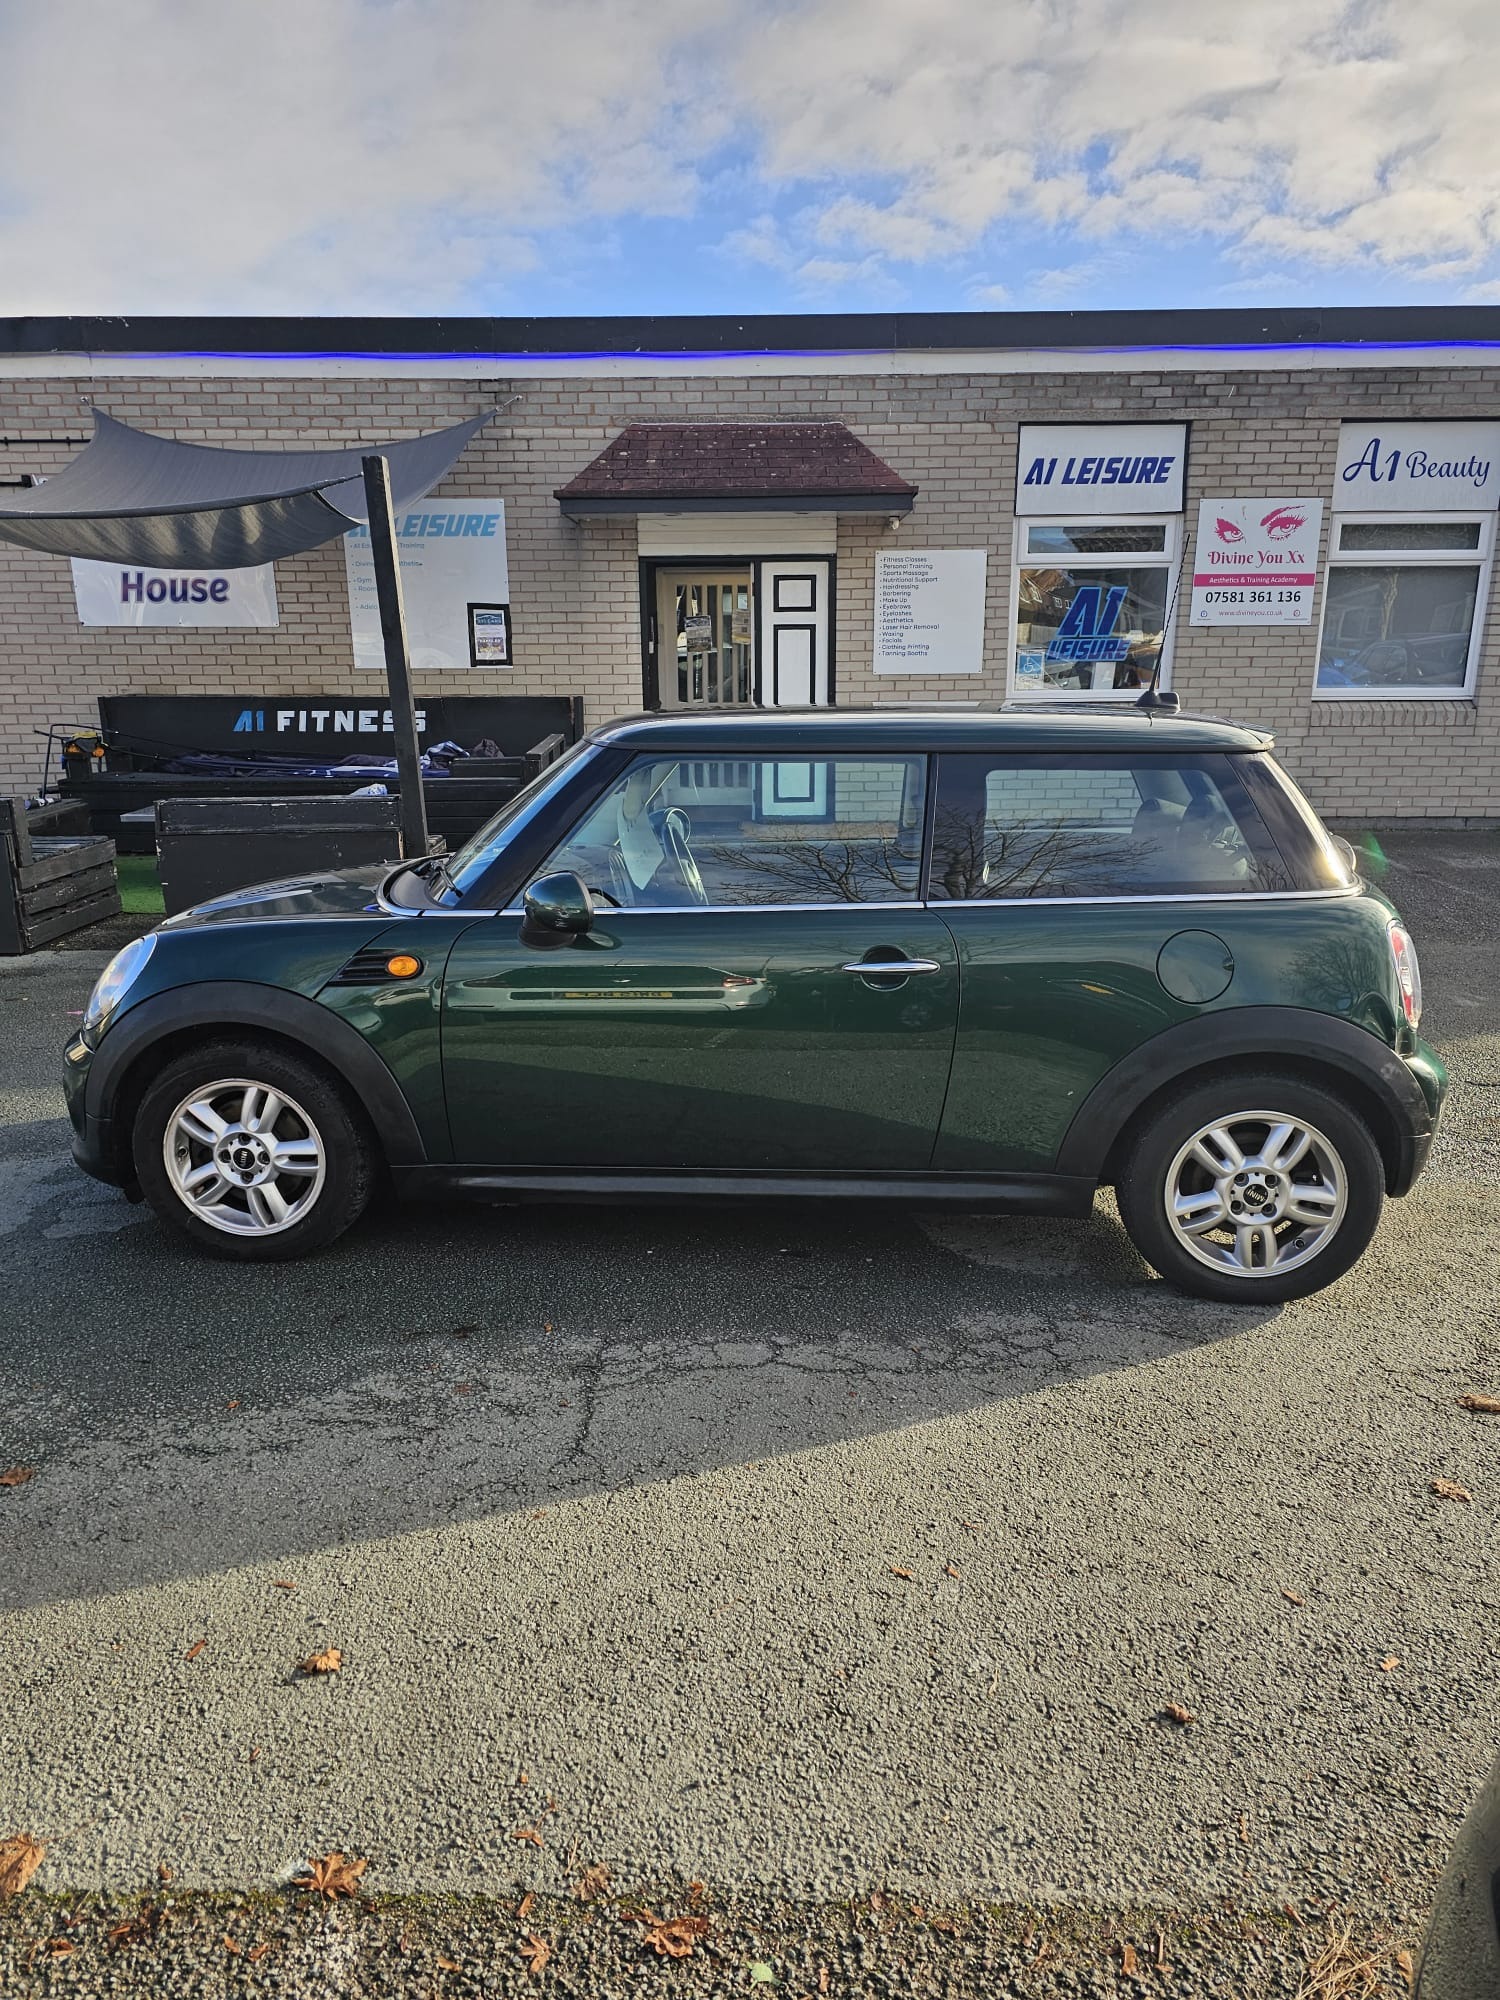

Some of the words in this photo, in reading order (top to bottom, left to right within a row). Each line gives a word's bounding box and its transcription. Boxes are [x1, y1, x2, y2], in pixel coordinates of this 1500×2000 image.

[1023, 457, 1058, 485] A1
[1061, 456, 1176, 485] LEISURE
[1342, 438, 1401, 482] A1
[1406, 451, 1491, 487] Beauty
[400, 542, 425, 550] Training
[1208, 551, 1254, 565] Divine
[1256, 550, 1283, 568] You
[1286, 550, 1305, 564] Xx
[121, 571, 230, 603] House
[1247, 576, 1270, 585] Training
[1270, 576, 1298, 584] Academy
[1205, 591, 1245, 603] 07581
[1249, 591, 1273, 603] 361
[1277, 591, 1301, 602] 136
[1056, 586, 1128, 637] A1
[1045, 638, 1132, 662] LEISURE
[233, 710, 265, 732] A1
